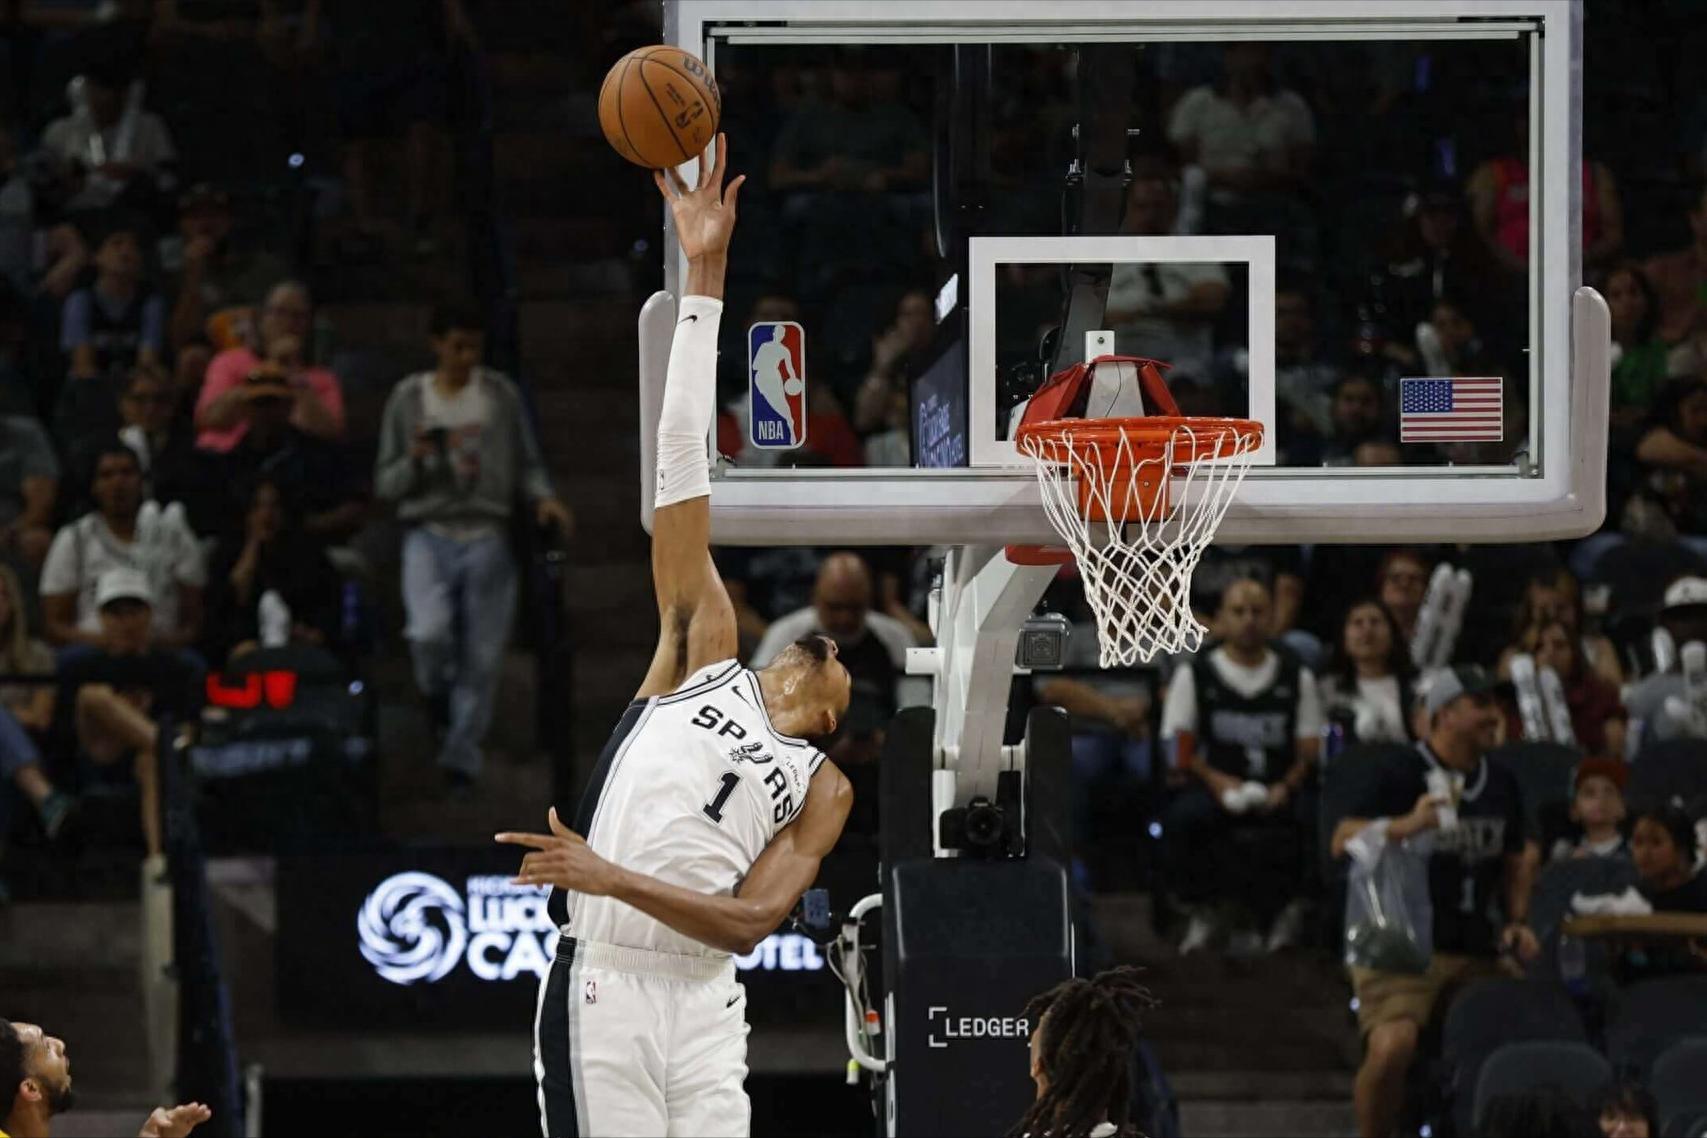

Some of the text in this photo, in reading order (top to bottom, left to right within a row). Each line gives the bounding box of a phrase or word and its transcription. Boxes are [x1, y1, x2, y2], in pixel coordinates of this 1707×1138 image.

[758, 420, 784, 440] NBA
[691, 704, 793, 824] SPURS
[702, 771, 741, 825] 1
[945, 1018, 1029, 1036] LEDGER
